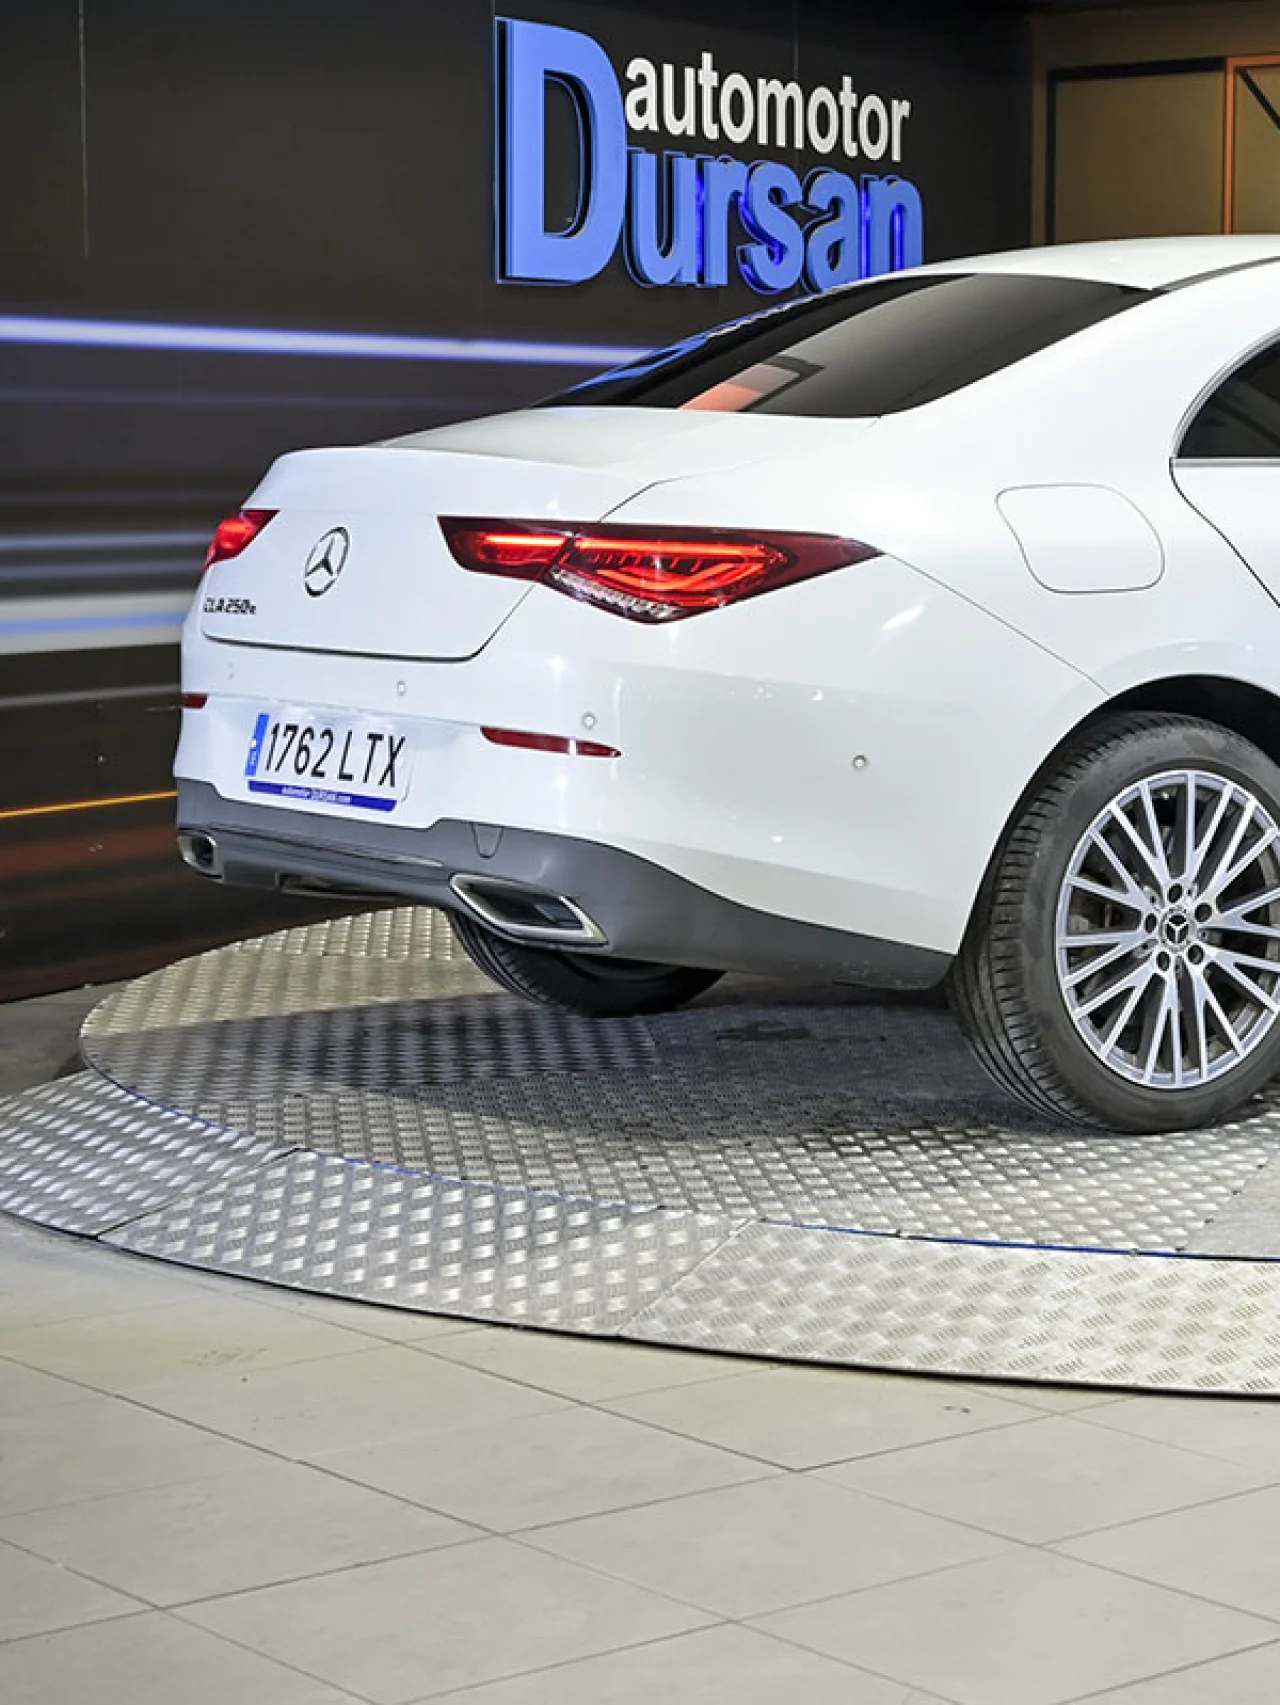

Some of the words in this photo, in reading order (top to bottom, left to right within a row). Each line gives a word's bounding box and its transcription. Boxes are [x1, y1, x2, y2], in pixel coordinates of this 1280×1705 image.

[495, 17, 924, 295] Dursan
[625, 52, 911, 162] automotor
[265, 722, 334, 778] 1762
[337, 729, 406, 788] LTX
